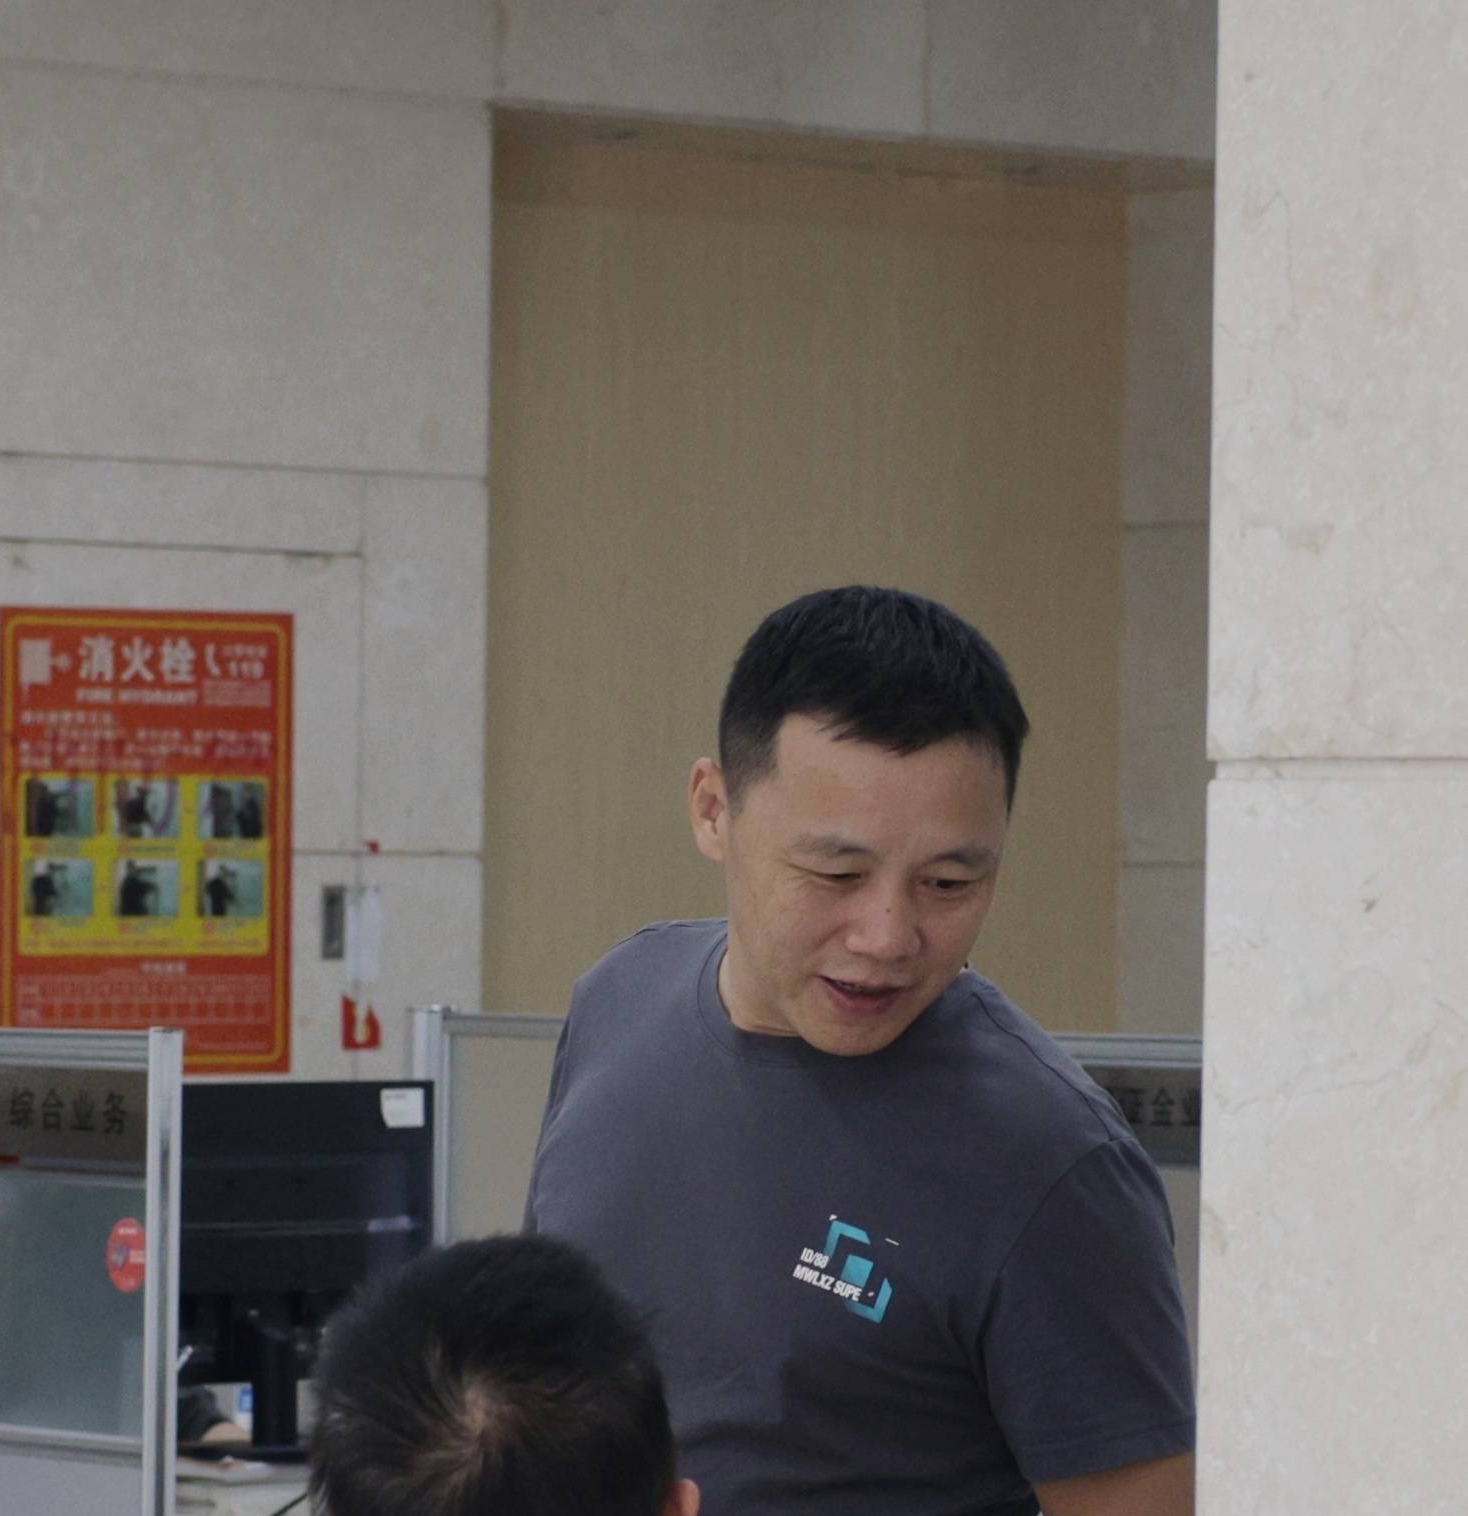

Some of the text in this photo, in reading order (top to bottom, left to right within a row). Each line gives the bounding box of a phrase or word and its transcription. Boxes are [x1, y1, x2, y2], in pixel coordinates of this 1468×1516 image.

[78, 636, 197, 684] 消火栓
[8, 1086, 129, 1136] 综合业务
